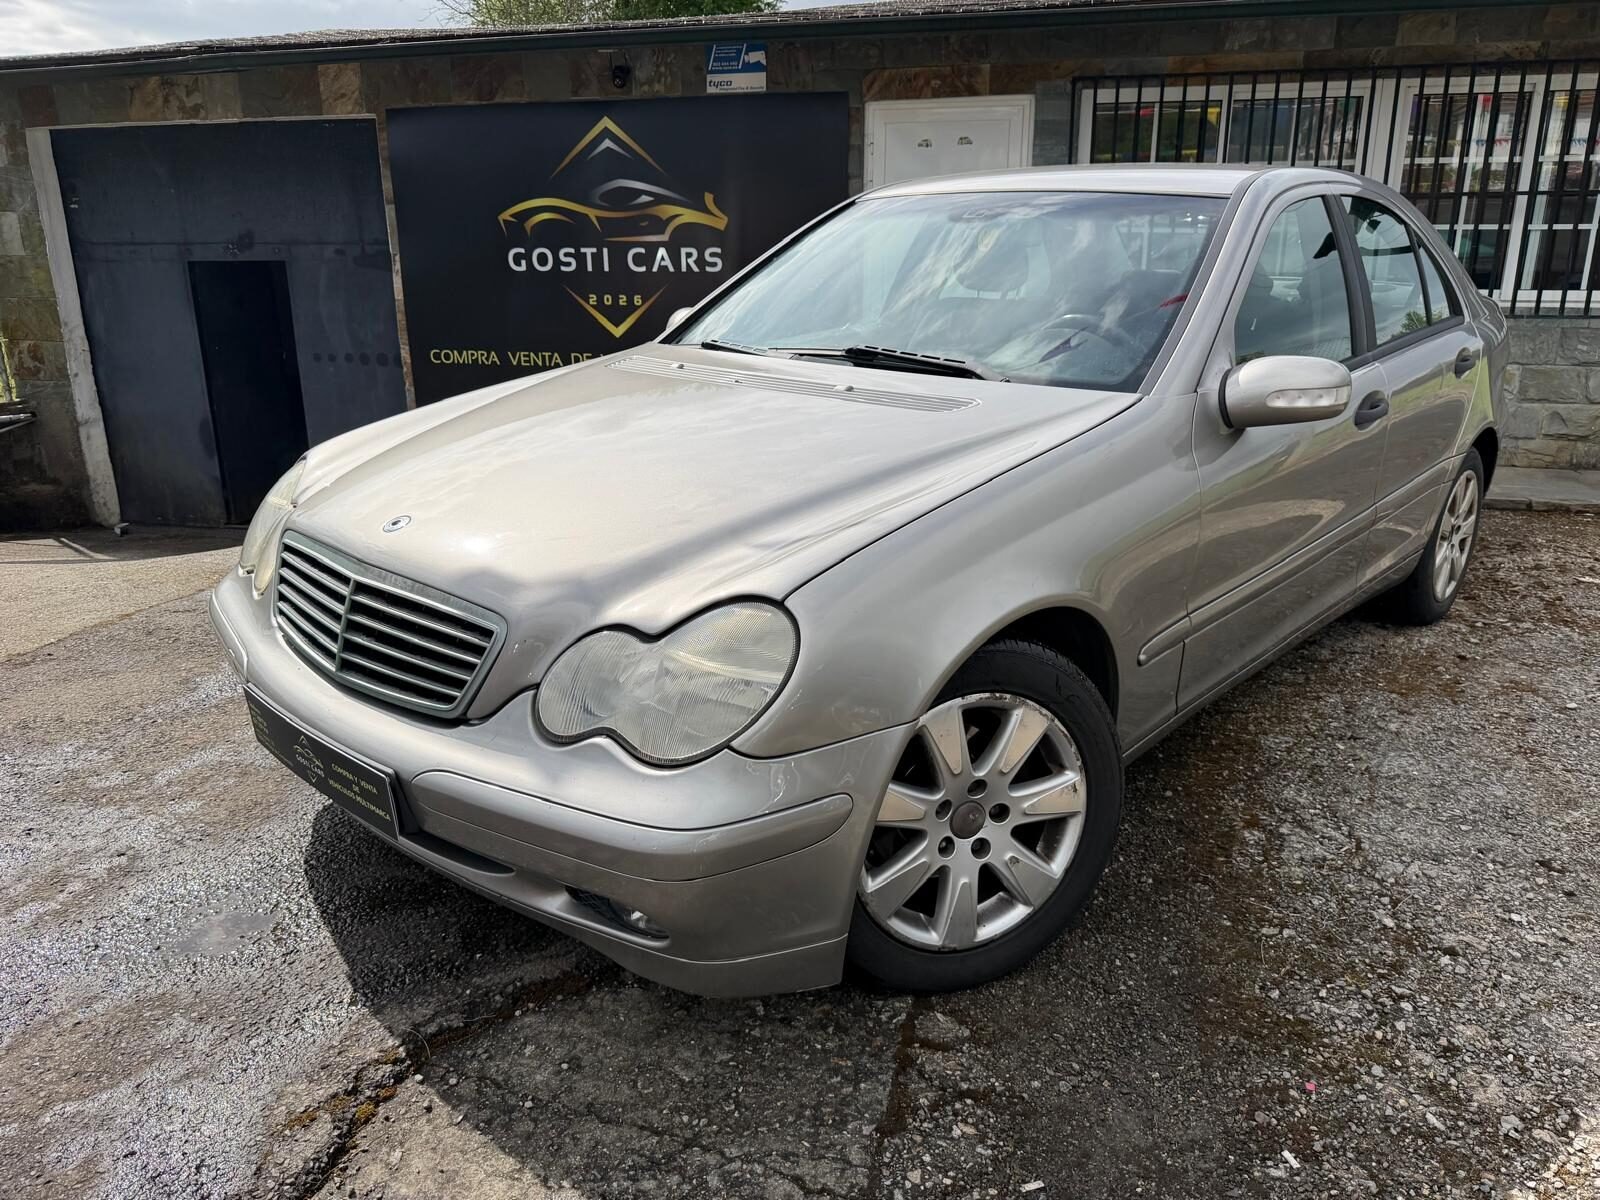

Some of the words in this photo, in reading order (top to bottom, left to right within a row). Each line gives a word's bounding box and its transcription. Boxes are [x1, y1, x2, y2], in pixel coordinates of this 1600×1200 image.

[708, 79, 733, 89] tyco
[507, 247, 610, 272] GOSTI
[626, 247, 723, 272] CARS
[588, 294, 643, 306] 2026
[430, 349, 500, 366] COMPRA
[508, 351, 563, 367] VENTA
